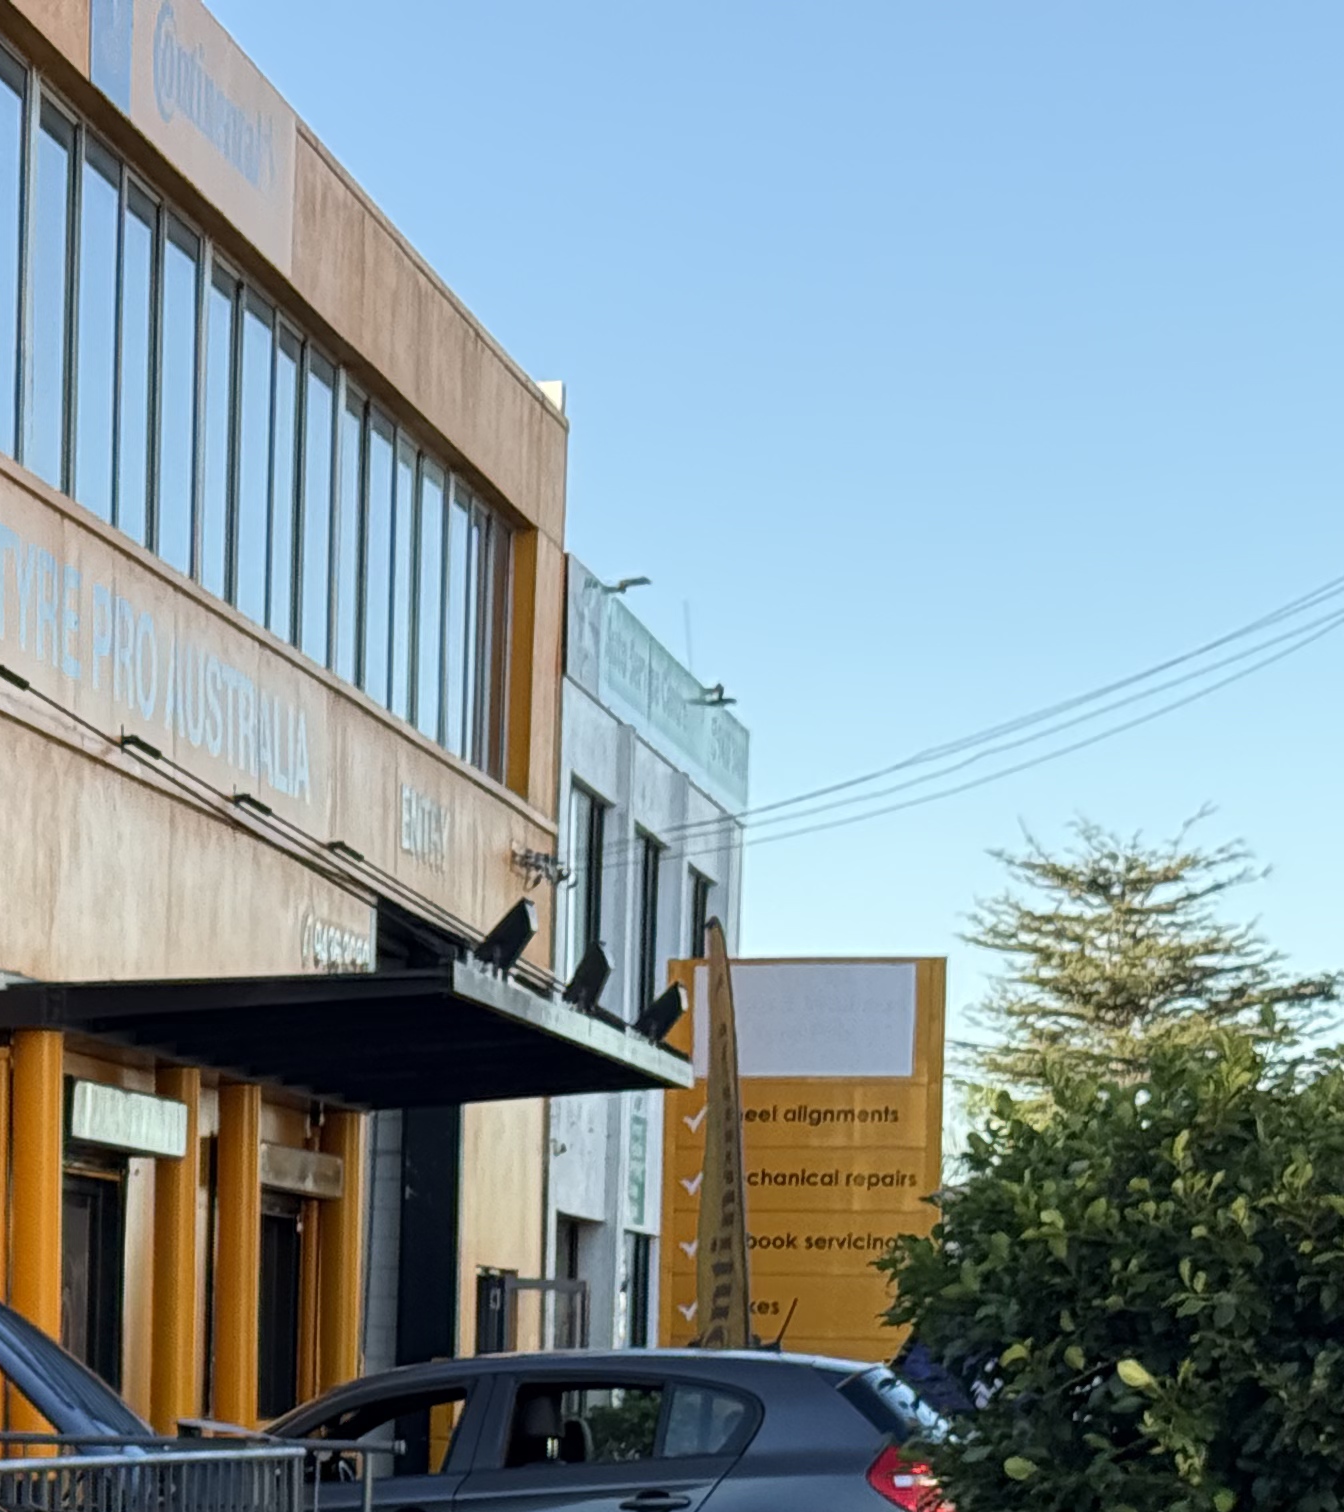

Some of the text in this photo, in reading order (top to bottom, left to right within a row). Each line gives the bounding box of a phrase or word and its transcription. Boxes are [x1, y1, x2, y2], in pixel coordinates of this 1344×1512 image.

[92, 582, 158, 721] PRO
[165, 636, 311, 805] AUSTRALIA
[783, 1105, 900, 1127] alignments
[747, 1168, 917, 1191] chanical repairs
